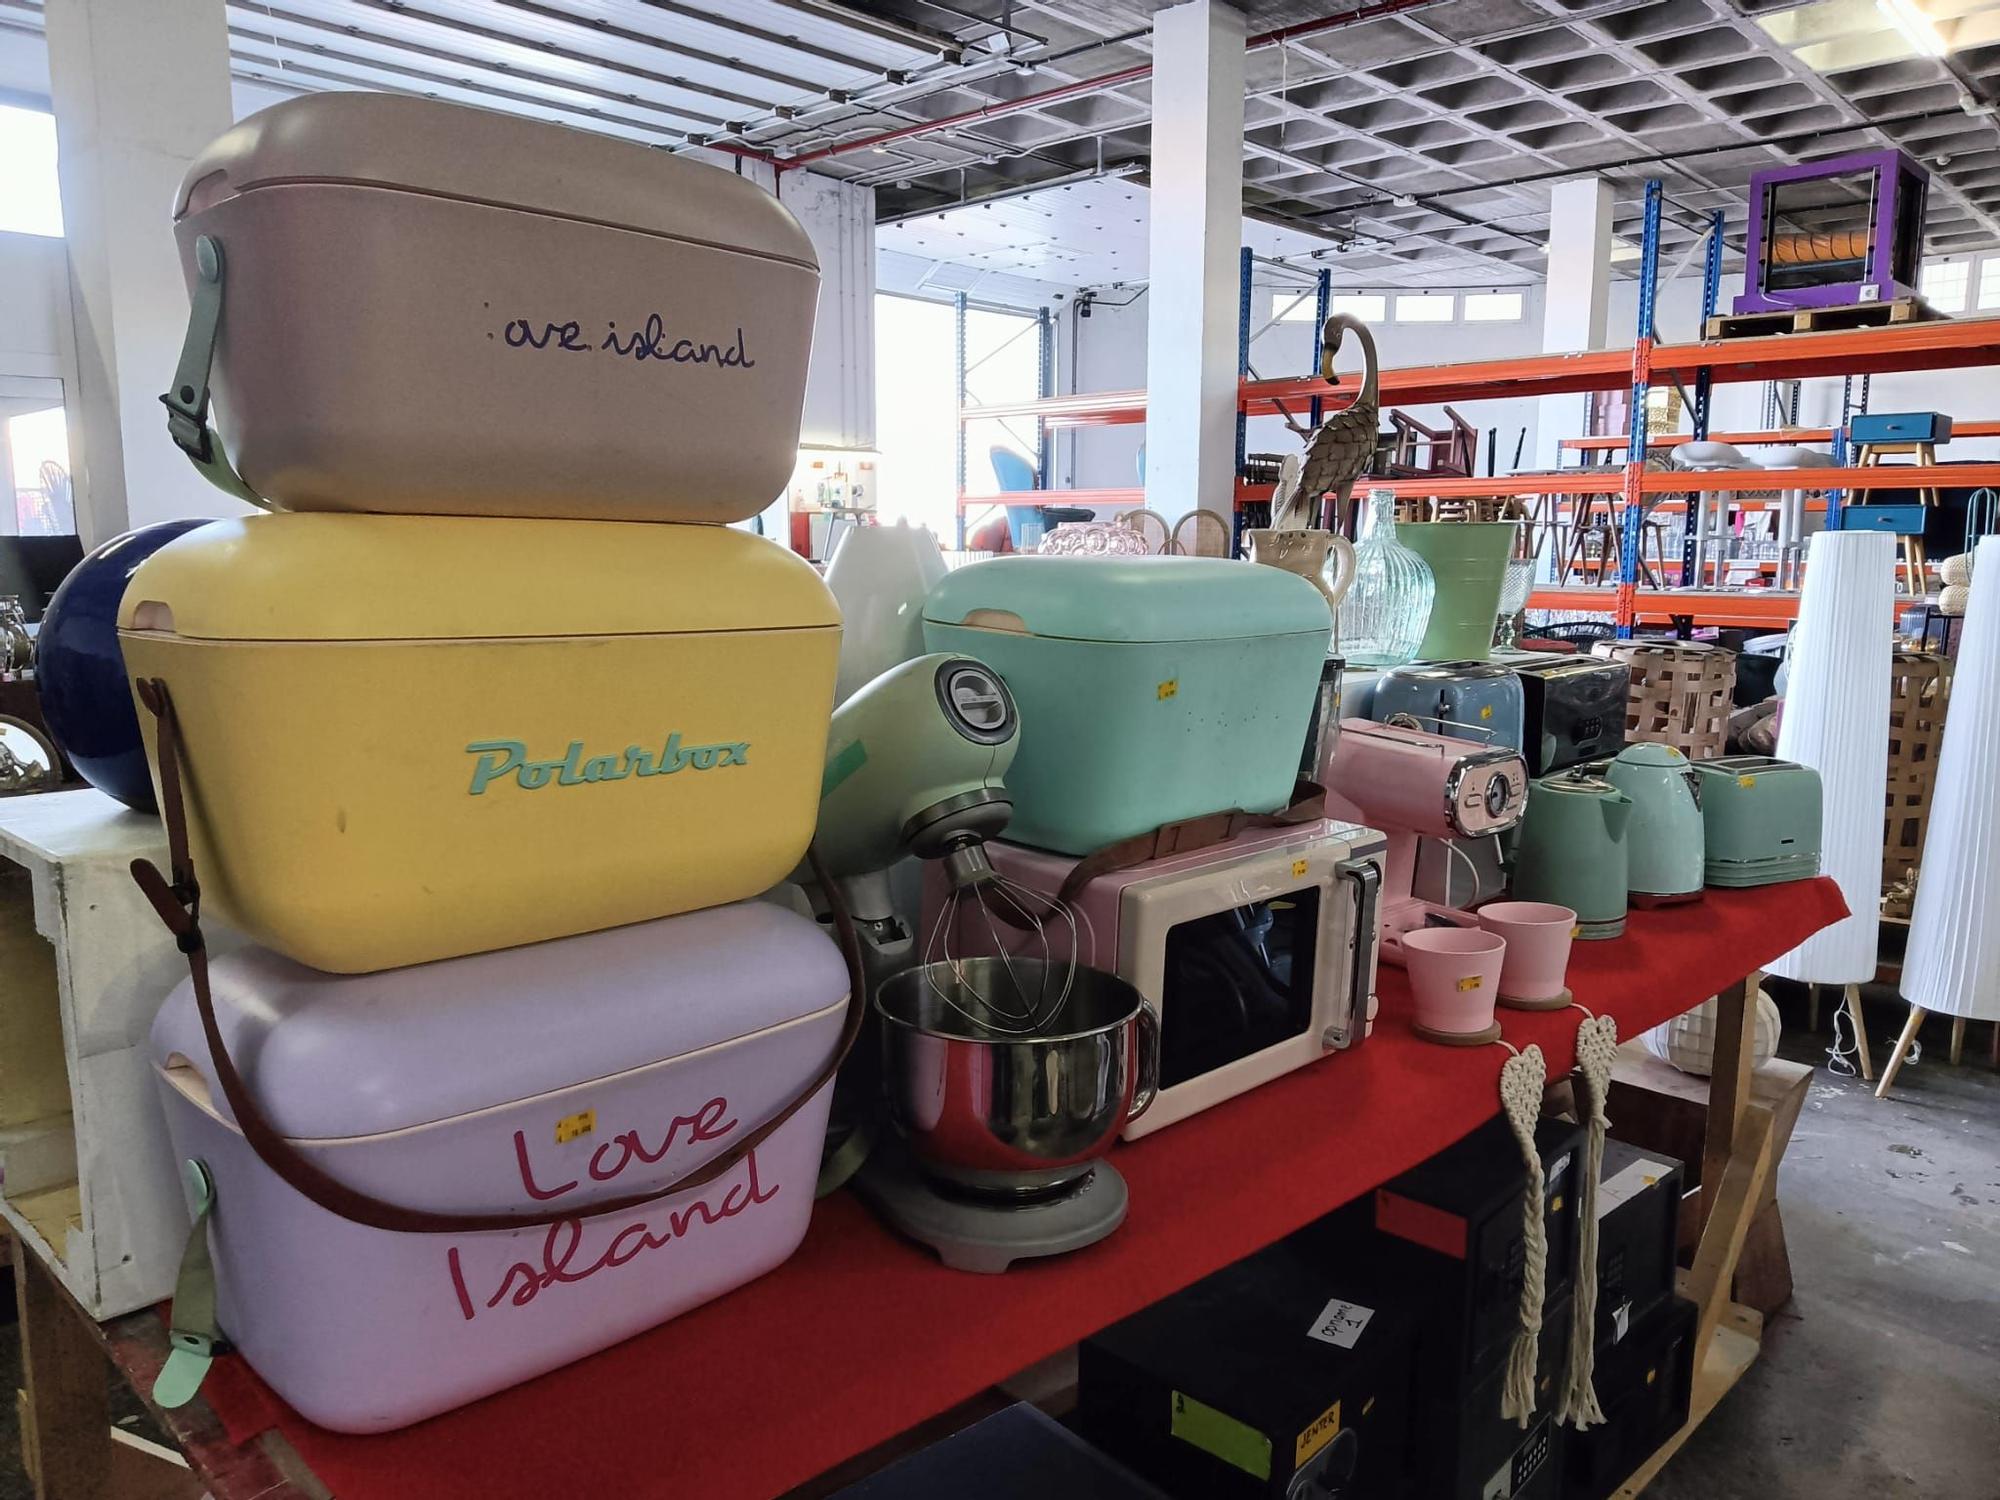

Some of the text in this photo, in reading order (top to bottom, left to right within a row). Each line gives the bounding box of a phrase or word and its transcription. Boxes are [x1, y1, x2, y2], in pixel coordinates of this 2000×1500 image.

[601, 313, 755, 368] island
[465, 731, 751, 796] Polarbox
[513, 1097, 738, 1200] Love
[447, 1149, 780, 1320] Island
